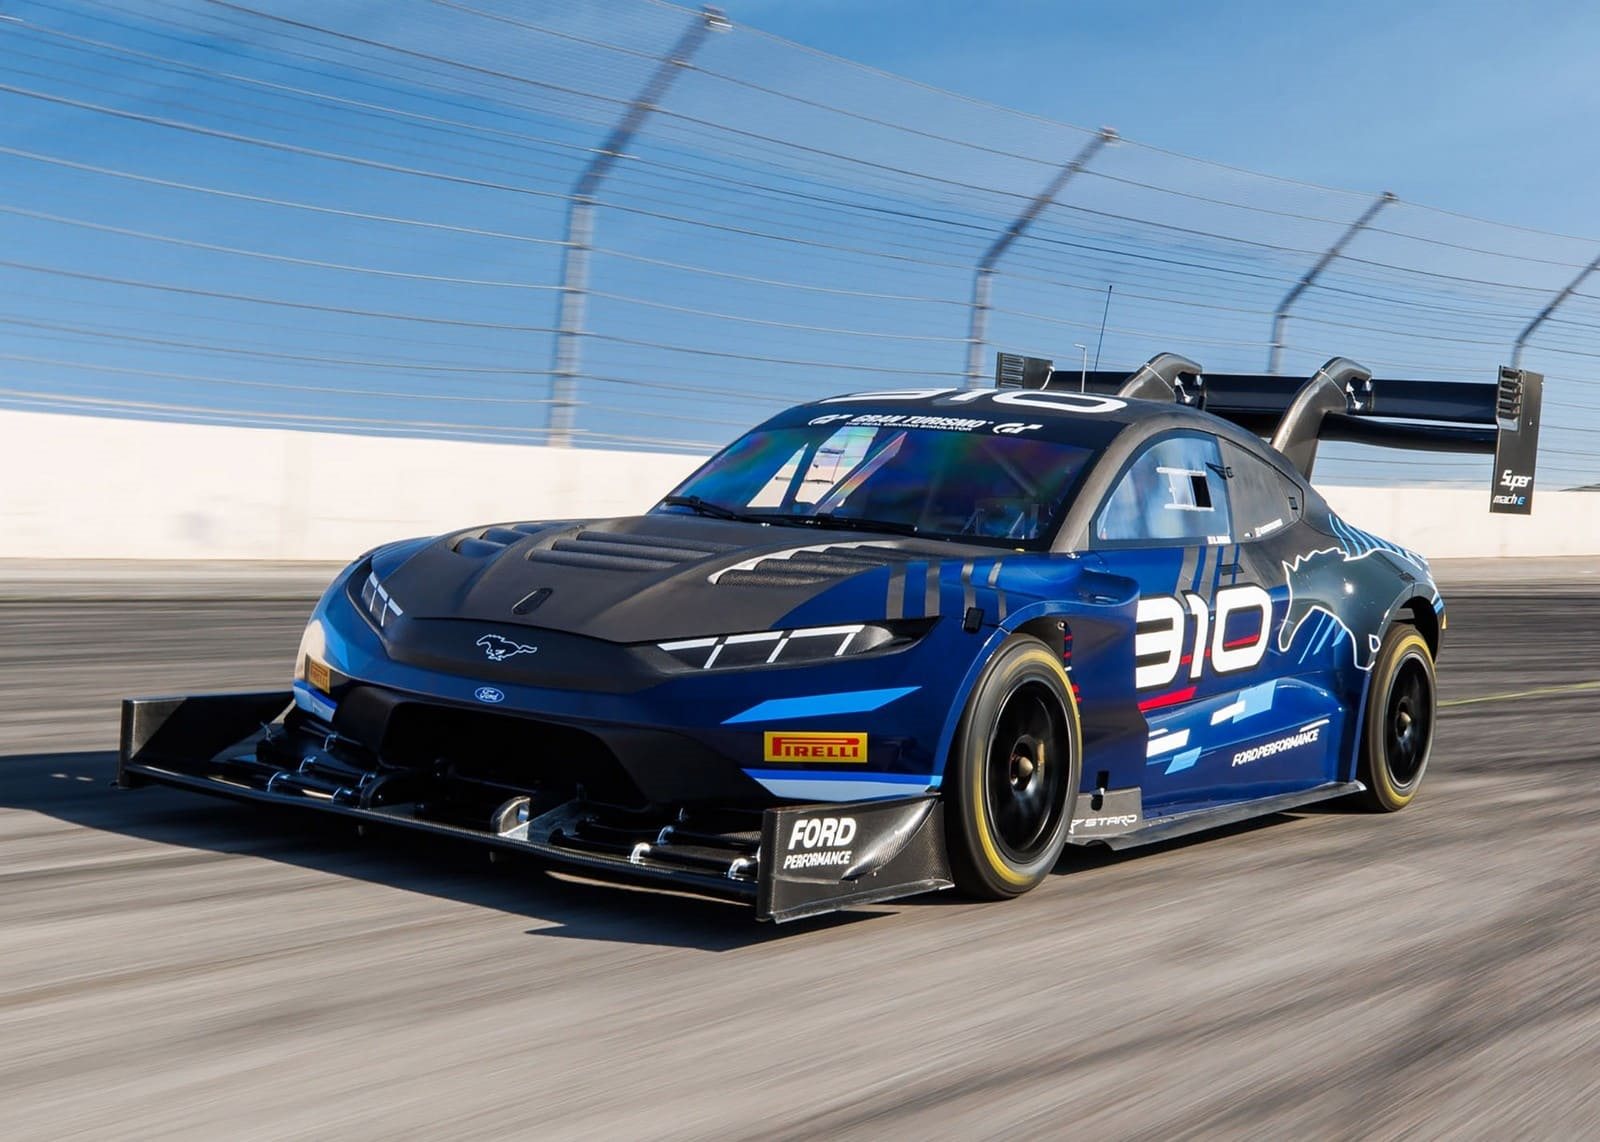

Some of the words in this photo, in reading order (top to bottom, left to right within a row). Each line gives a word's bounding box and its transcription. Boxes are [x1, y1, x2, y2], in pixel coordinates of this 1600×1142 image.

[851, 414, 906, 424] GRAN
[902, 415, 987, 428] TURISMO
[1500, 470, 1532, 491] Super
[1135, 585, 1272, 689] 310
[772, 737, 859, 757] PIRELLI
[1084, 814, 1137, 828] STARD
[787, 817, 857, 850] FORD
[783, 851, 852, 870] PERFORMANCE
